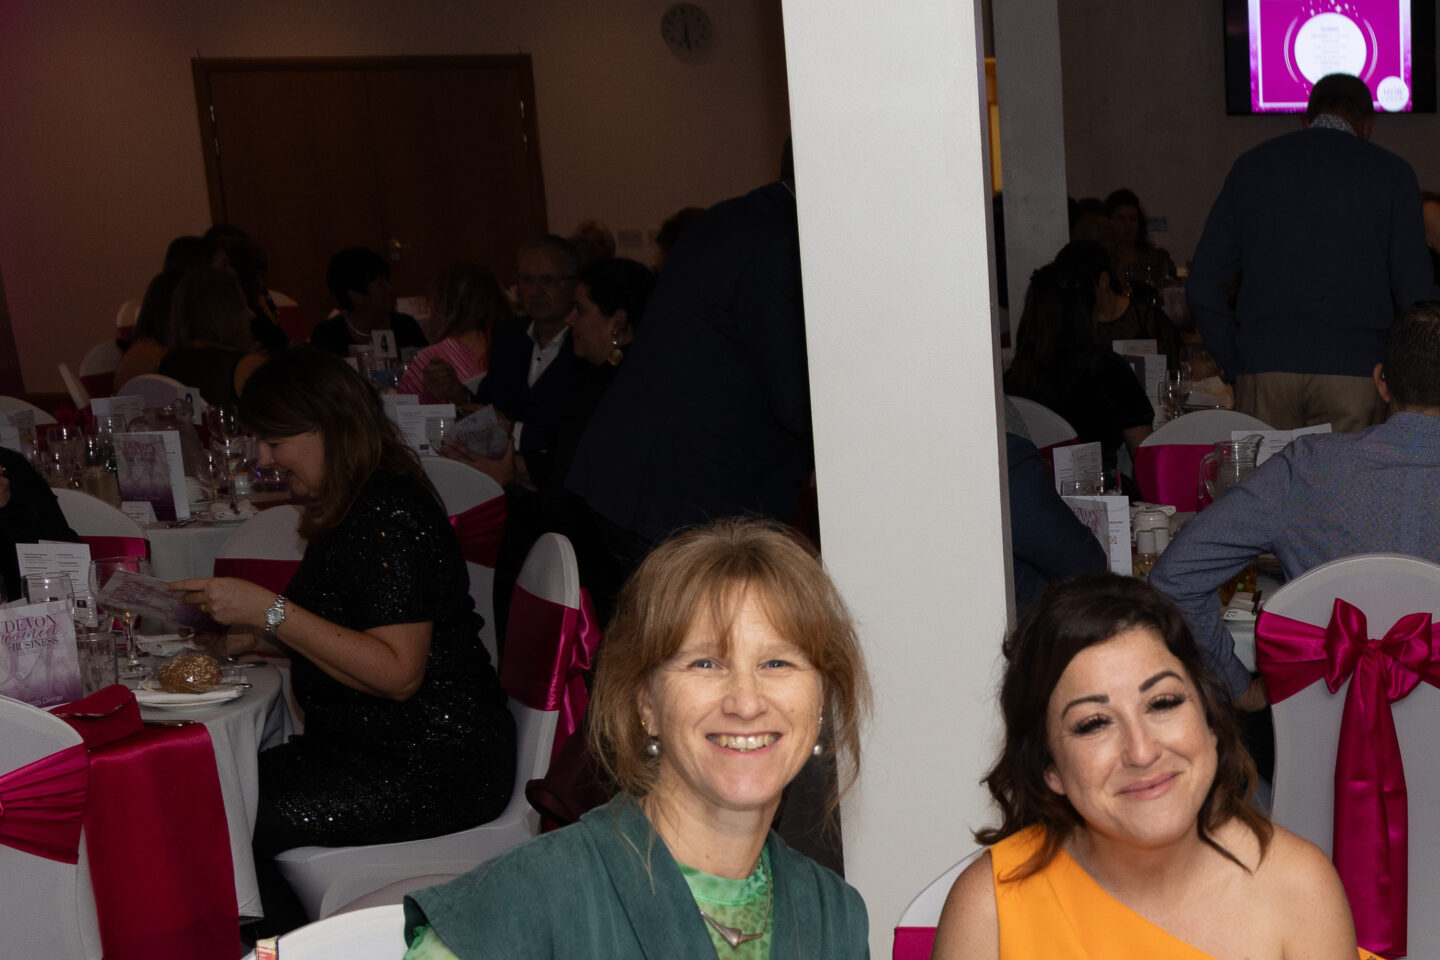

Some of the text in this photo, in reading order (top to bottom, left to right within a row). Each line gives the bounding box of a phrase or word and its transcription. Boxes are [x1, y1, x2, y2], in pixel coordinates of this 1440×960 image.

[381, 334, 390, 353] 4
[4, 614, 57, 634] DEVON
[13, 638, 59, 652] BUSINESS
